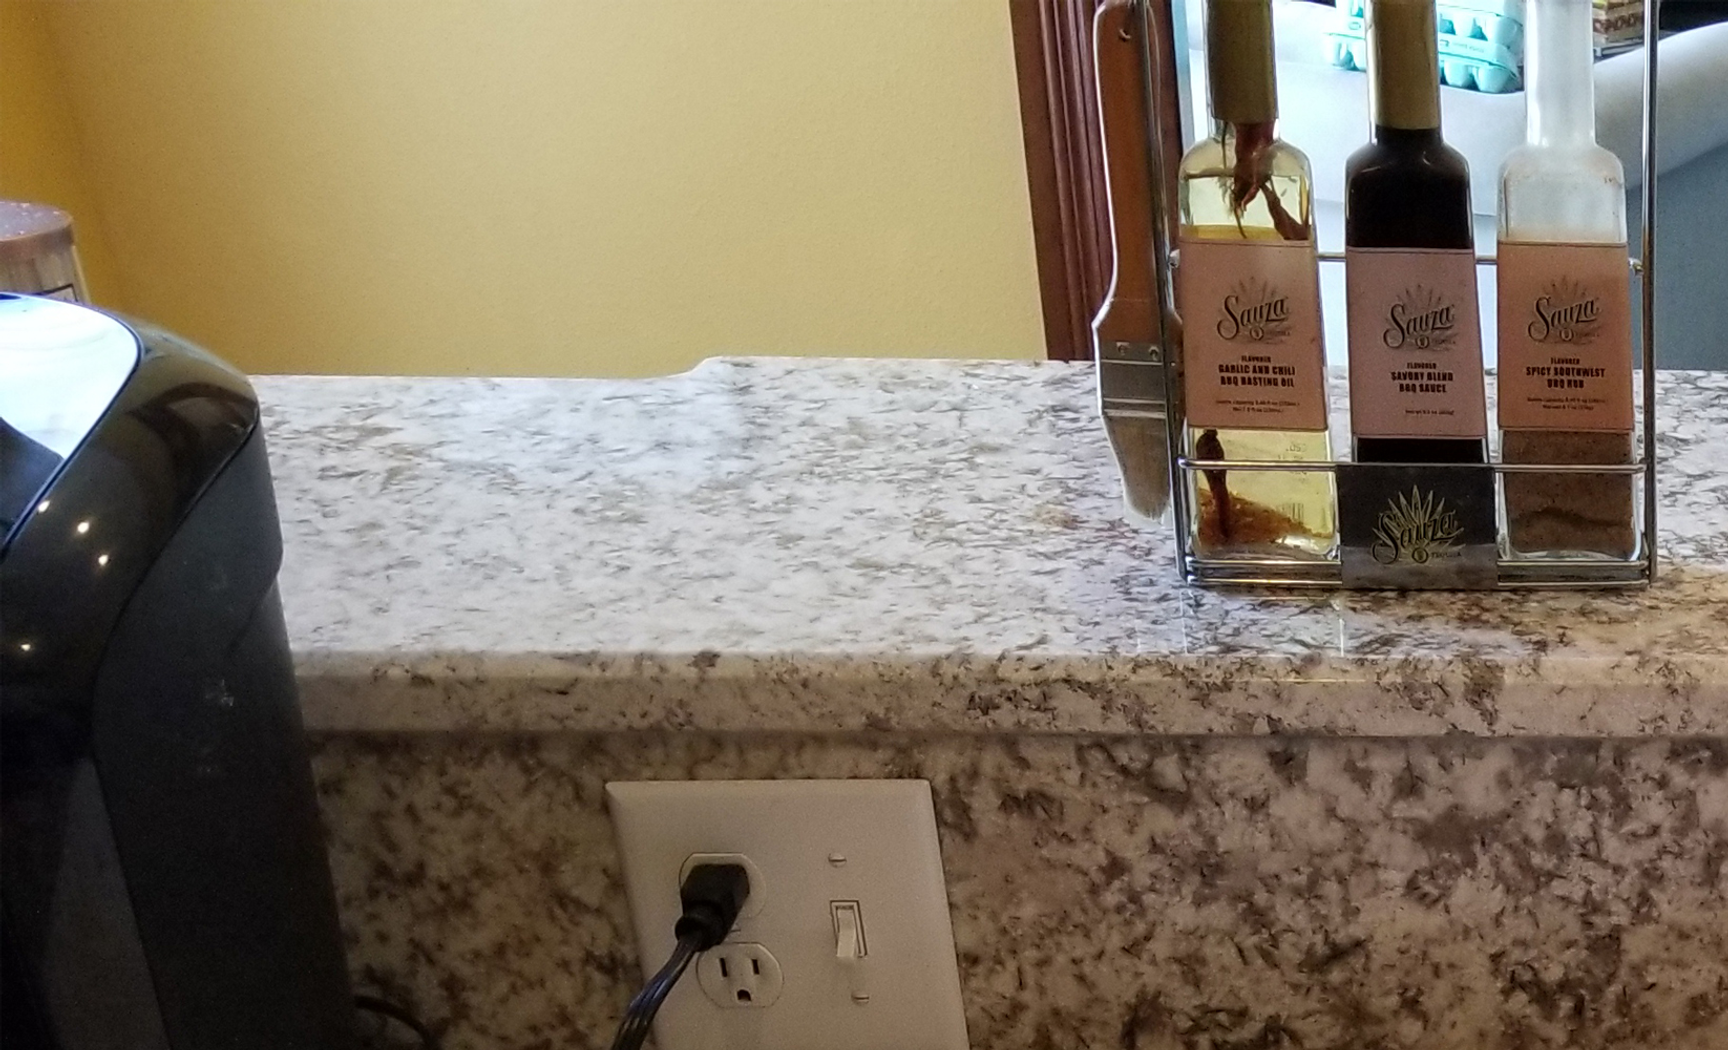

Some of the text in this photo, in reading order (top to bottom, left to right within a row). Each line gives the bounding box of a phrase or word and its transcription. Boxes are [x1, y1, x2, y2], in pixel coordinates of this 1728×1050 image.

[1217, 294, 1289, 340] Sauza
[1528, 296, 1600, 342] Sauza
[1383, 303, 1455, 349] Sauza
[1218, 364, 1296, 376] GARLIC AND CHILI
[1526, 366, 1606, 378] SPICY SOUTHWEST
[1220, 376, 1295, 388] BBQ BASTING OIL
[1391, 371, 1454, 382] SAVORY BLEND
[1399, 383, 1447, 394] BBQ SAUCE
[1371, 510, 1464, 565] Sauza
